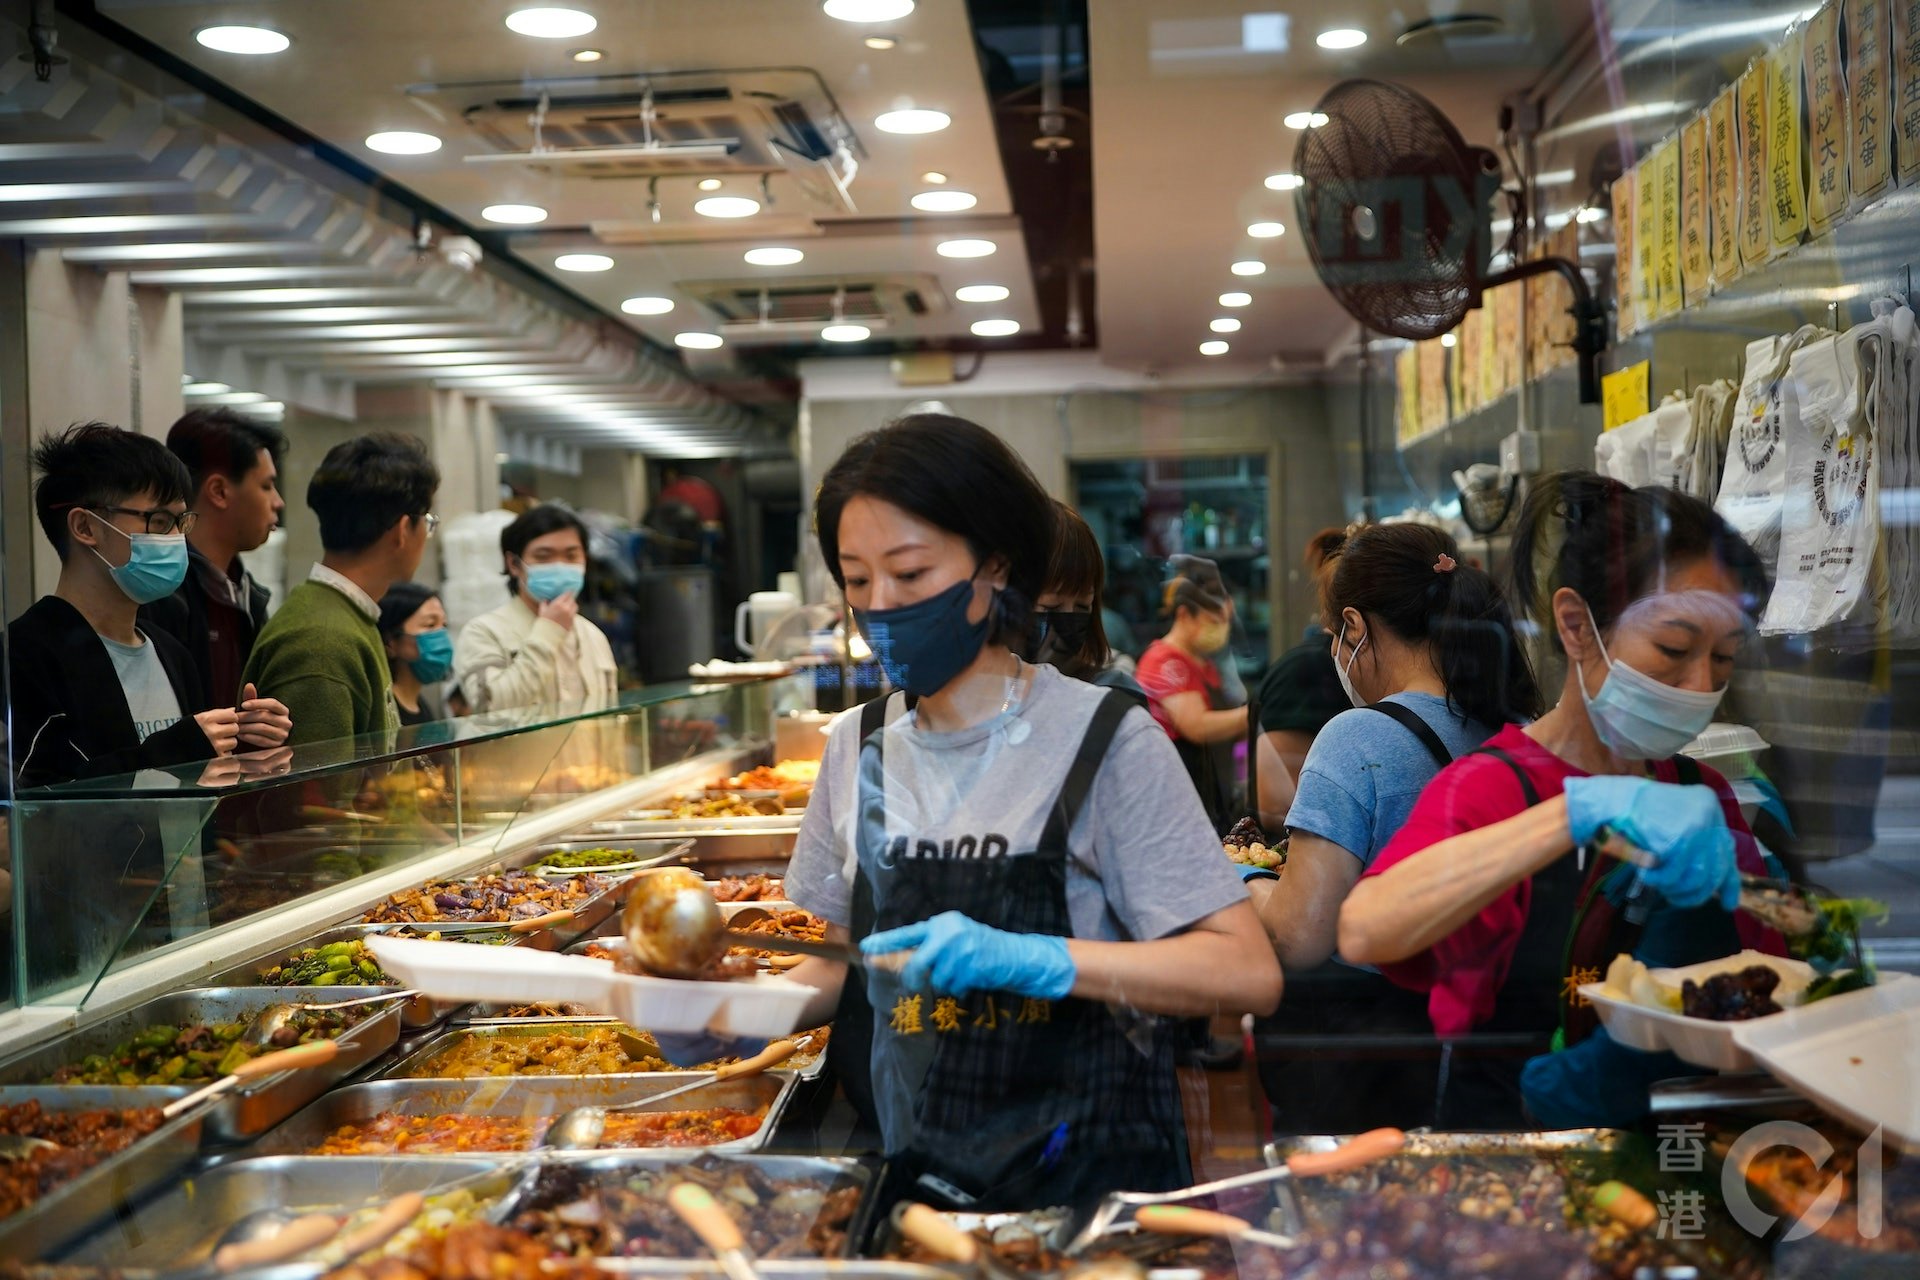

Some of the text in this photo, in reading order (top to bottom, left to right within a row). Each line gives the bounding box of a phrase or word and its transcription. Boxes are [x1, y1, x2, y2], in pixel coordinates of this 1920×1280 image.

[1812, 40, 1838, 196] 豉椒炒大蜆
[1857, 3, 1878, 169] 海鮮蒸水蛋
